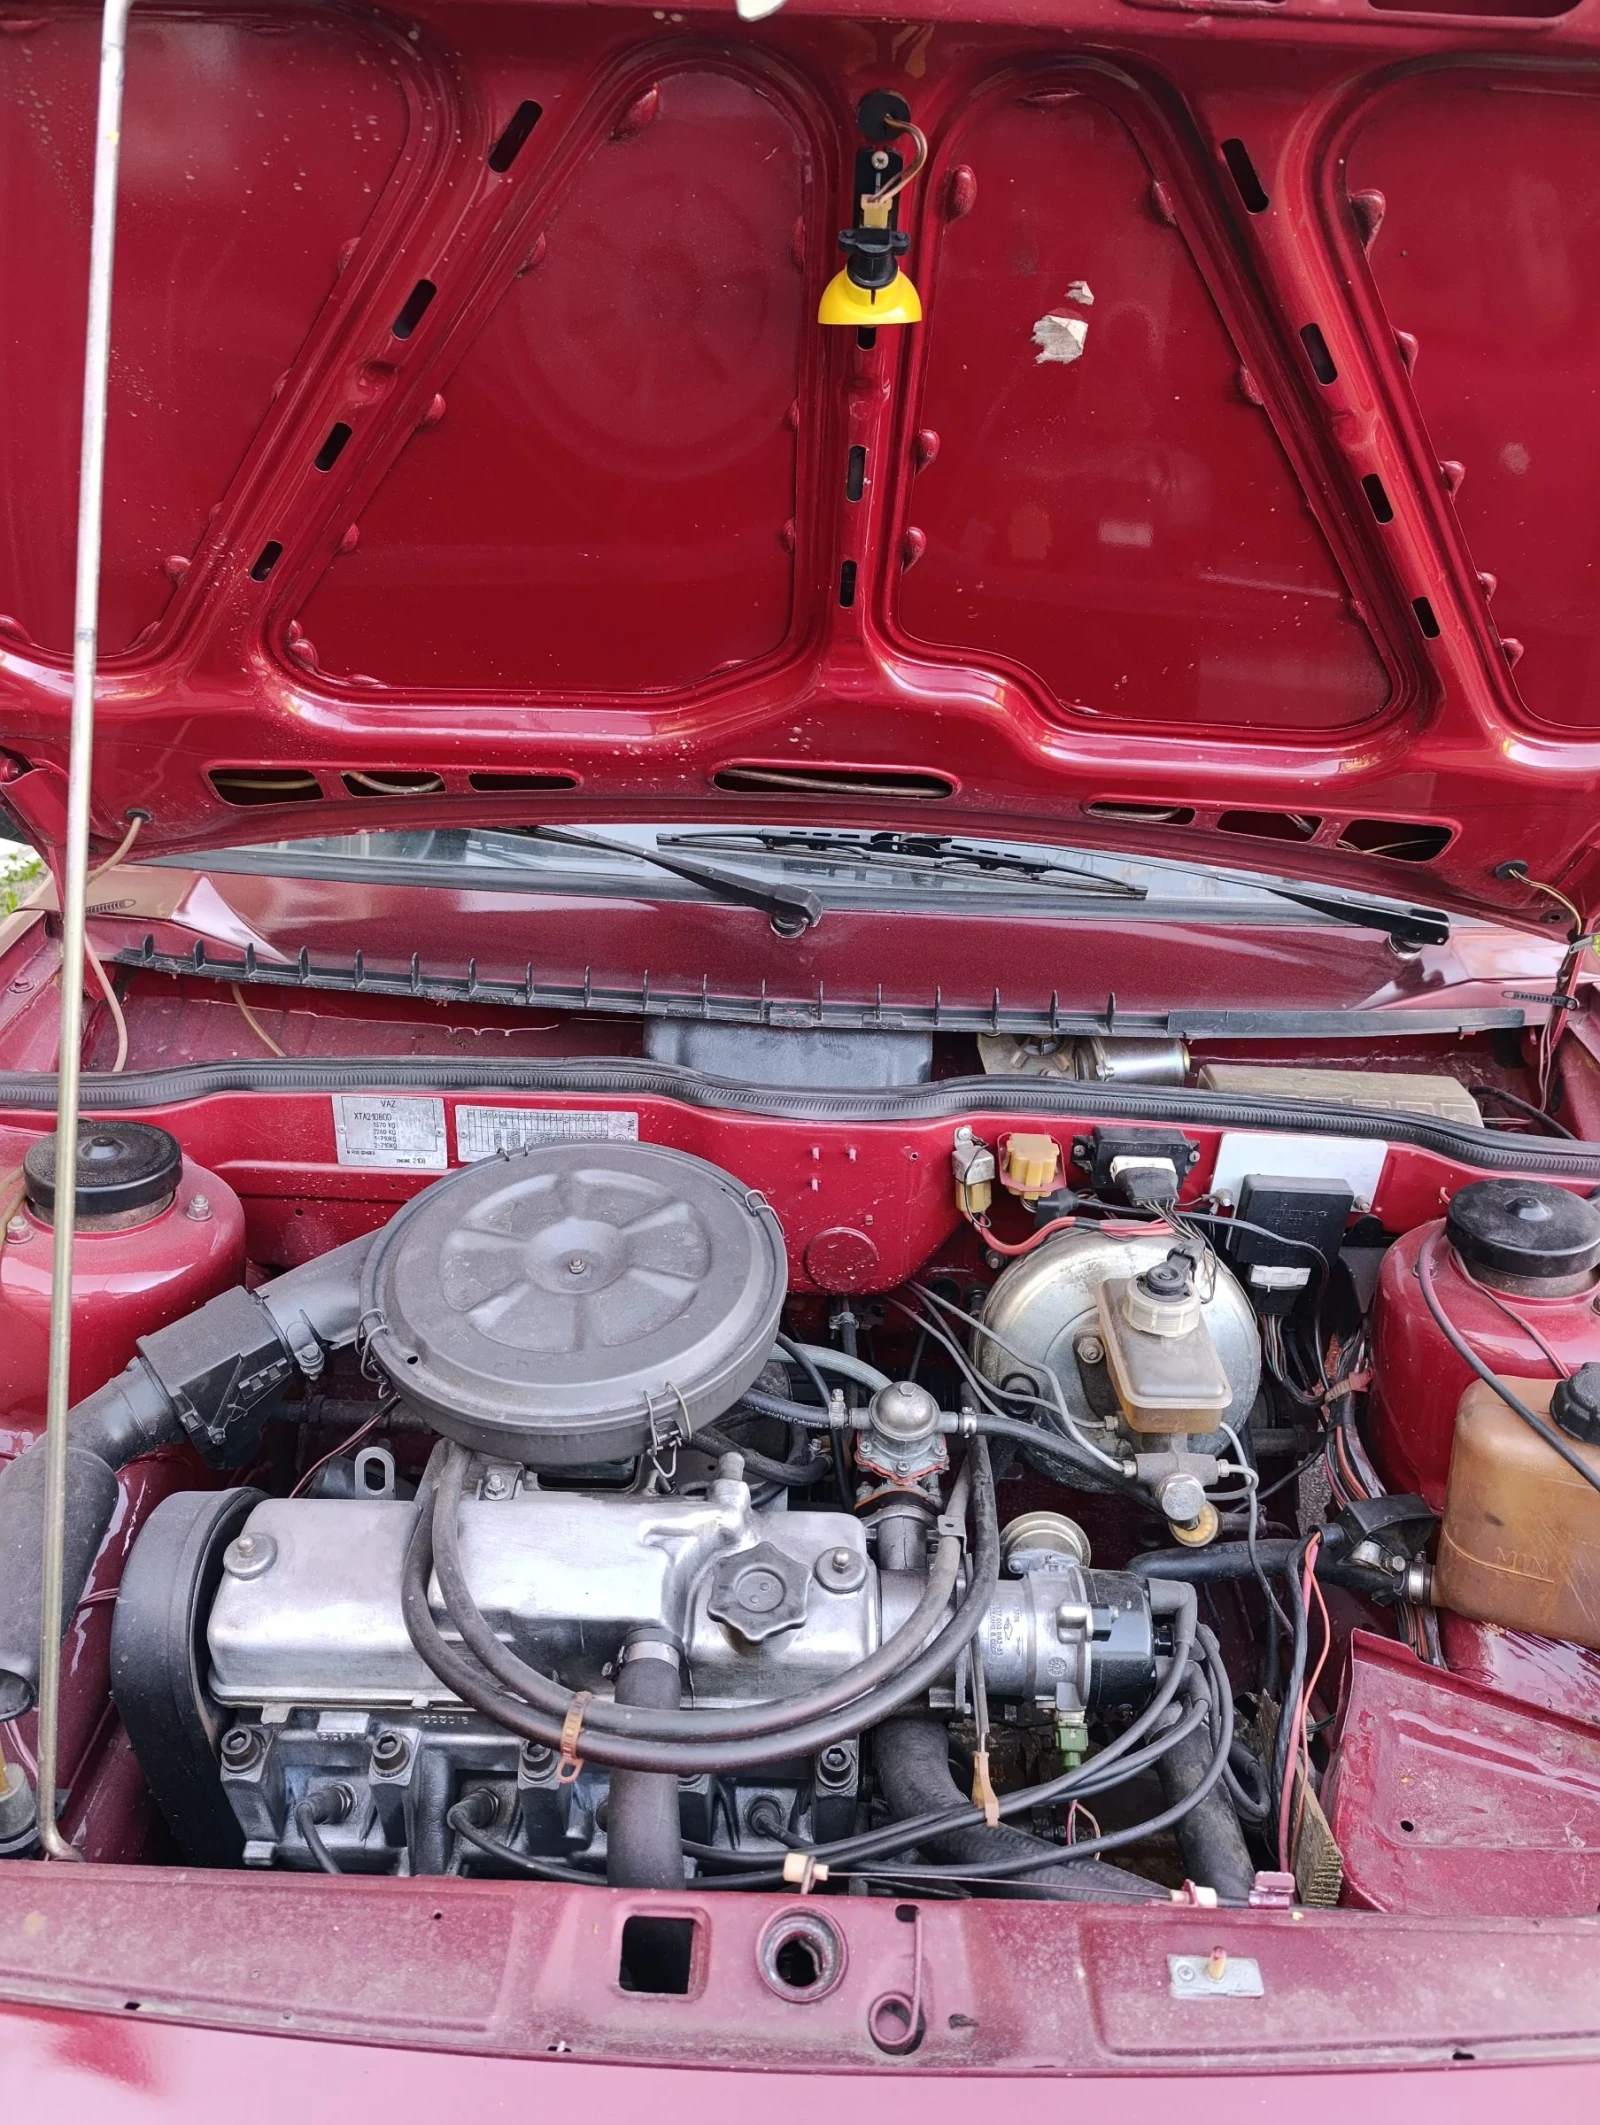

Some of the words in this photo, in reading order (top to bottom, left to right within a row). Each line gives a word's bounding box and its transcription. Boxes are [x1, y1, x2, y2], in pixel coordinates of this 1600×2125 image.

[380, 1100, 396, 1108] VAZ
[627, 1119, 635, 1132] VAZ
[1497, 1546, 1549, 1575] MIN
